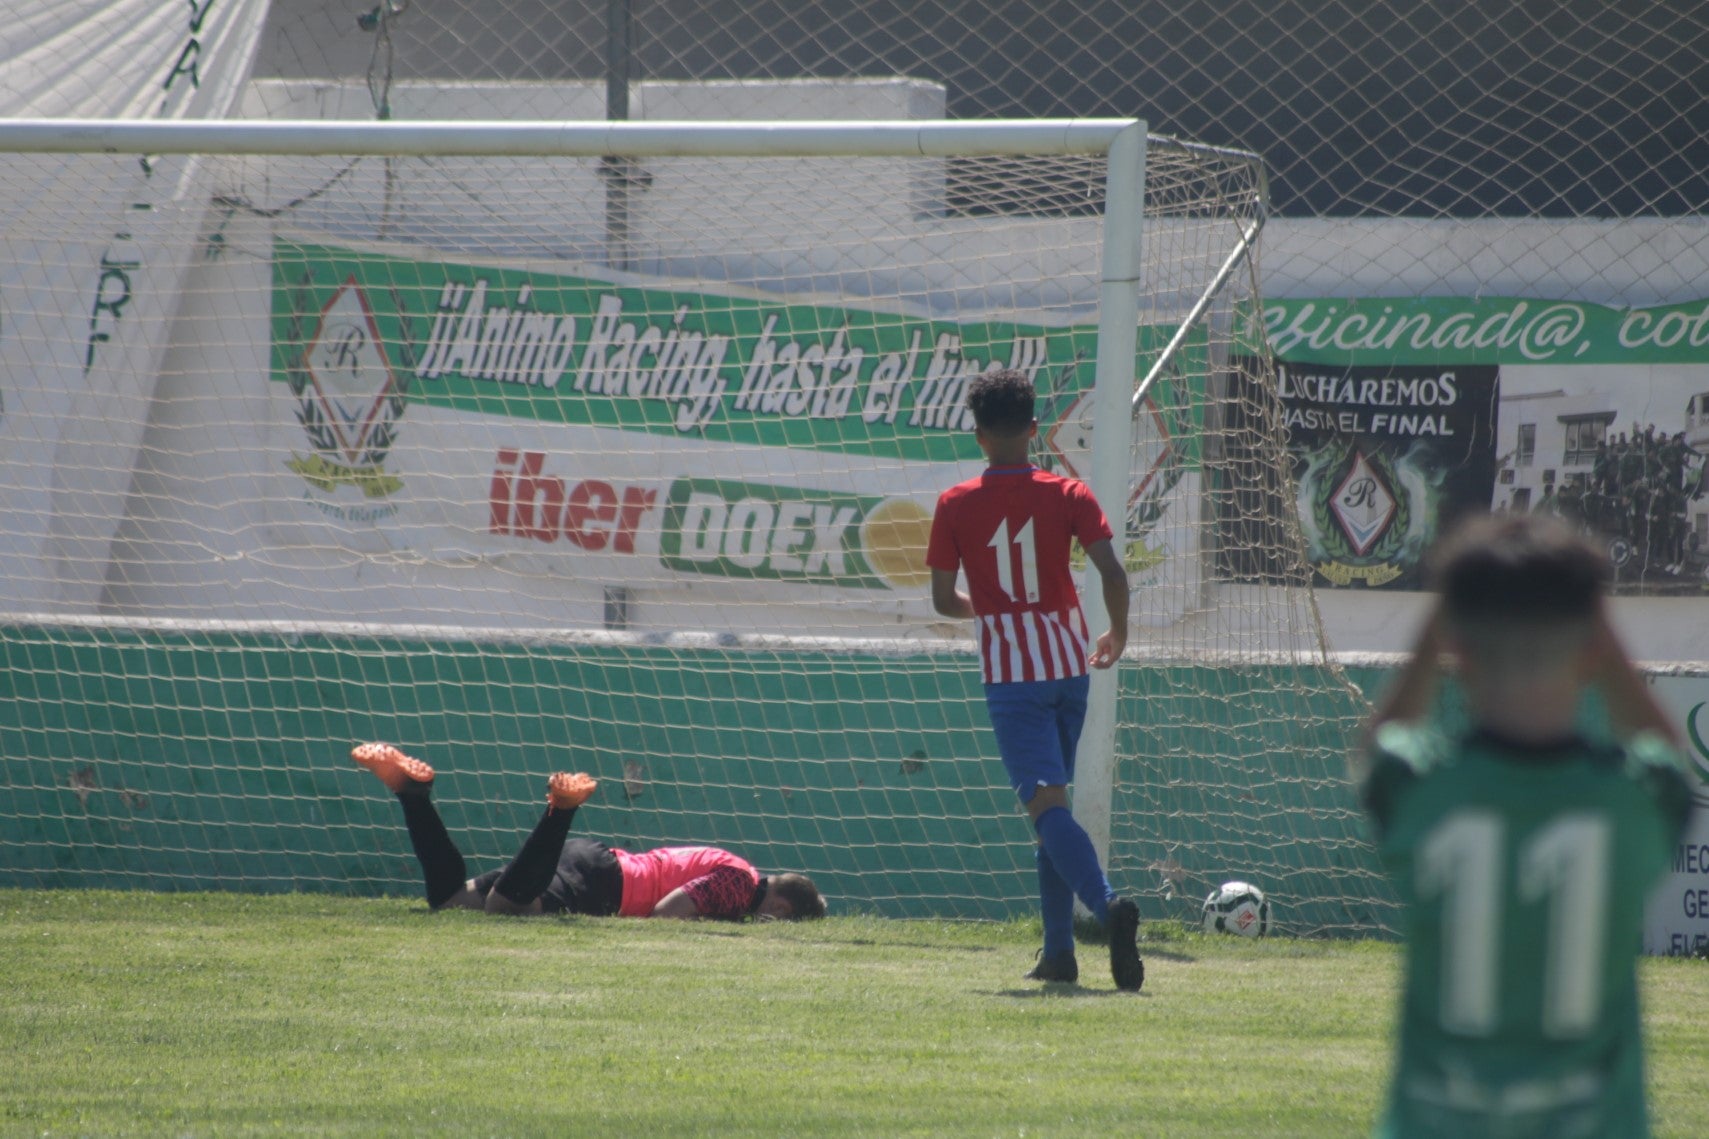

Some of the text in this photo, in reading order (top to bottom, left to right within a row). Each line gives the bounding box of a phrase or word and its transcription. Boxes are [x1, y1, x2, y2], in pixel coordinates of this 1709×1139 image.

[574, 293, 729, 433] Racing,
[733, 313, 864, 419] hasta
[862, 328, 921, 424] el
[1370, 414, 1454, 436] FINAL
[489, 447, 656, 555] iber
[986, 516, 1041, 605] 11
[1415, 811, 1612, 1040] 11
